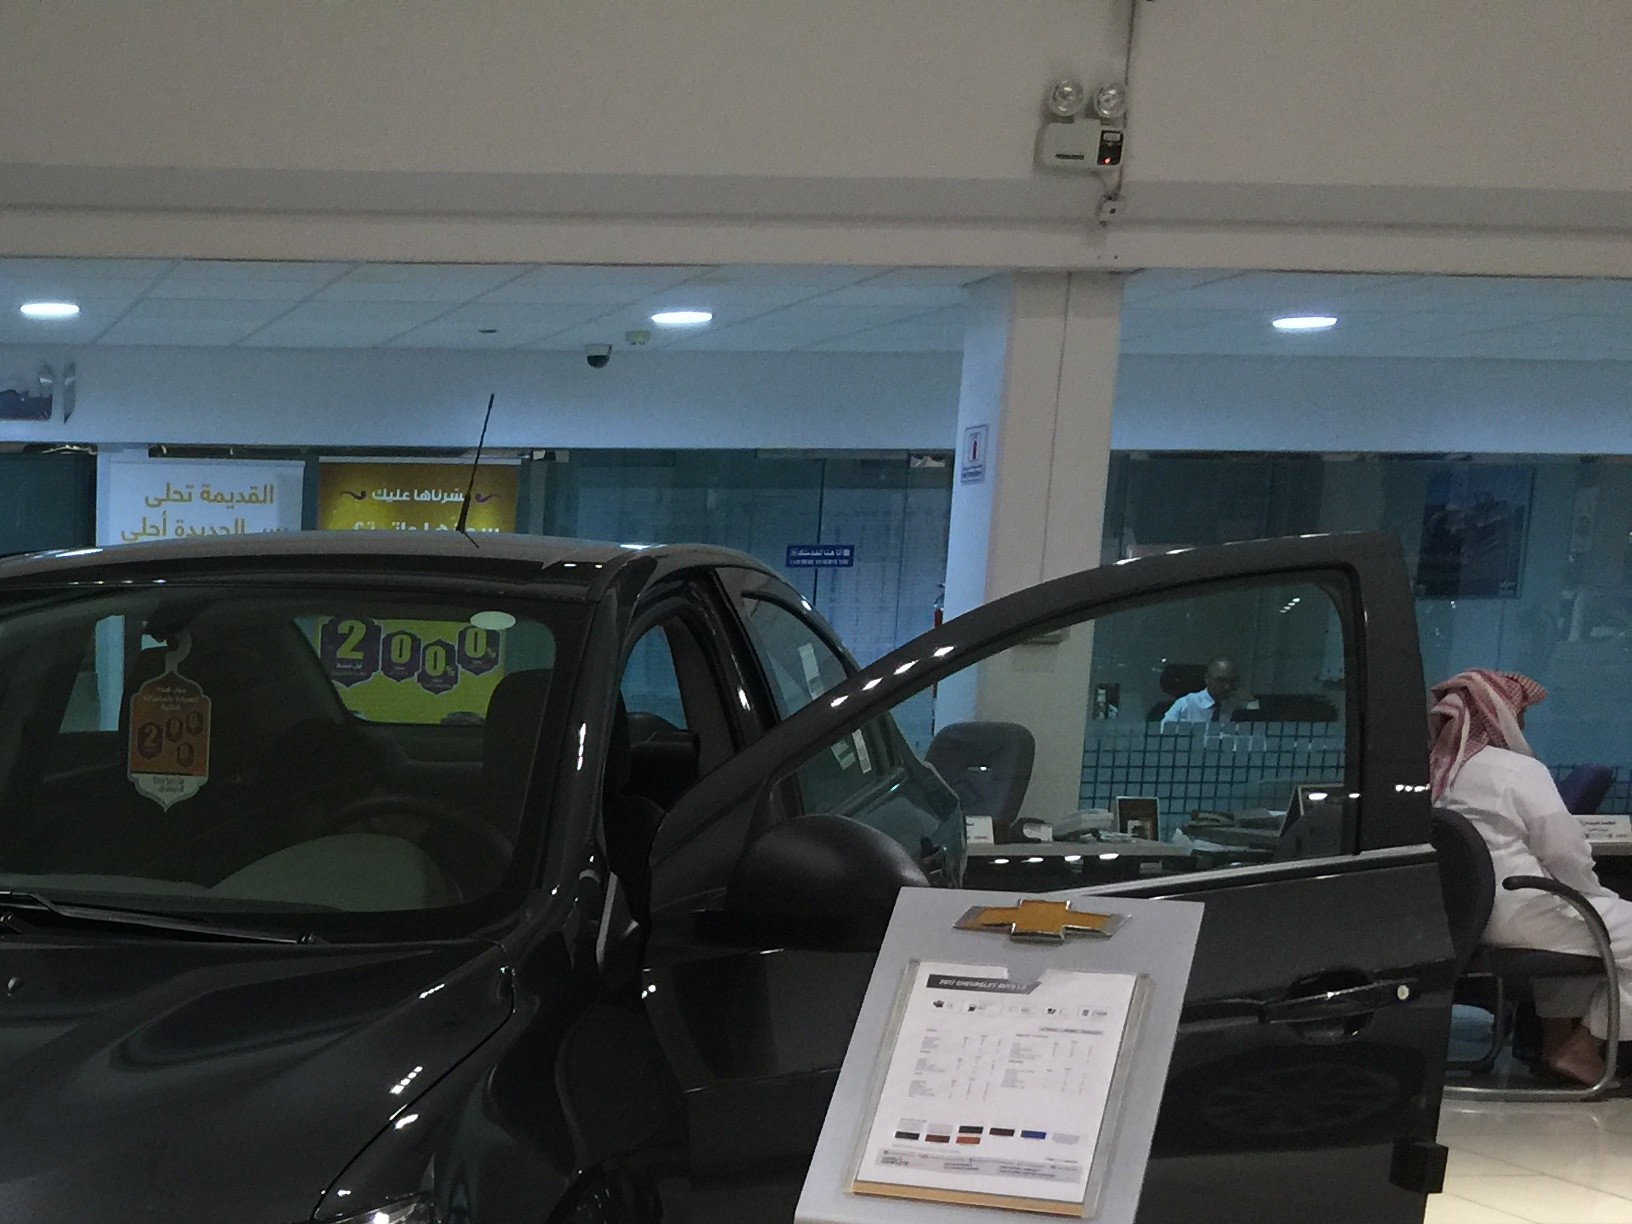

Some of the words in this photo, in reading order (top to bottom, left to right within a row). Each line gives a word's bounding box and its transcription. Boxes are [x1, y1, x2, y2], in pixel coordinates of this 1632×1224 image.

[199, 484, 274, 509] القديمة
[371, 488, 410, 504] عليك
[336, 620, 367, 660] 2
[390, 635, 412, 664] 0
[143, 725, 158, 748] 2
